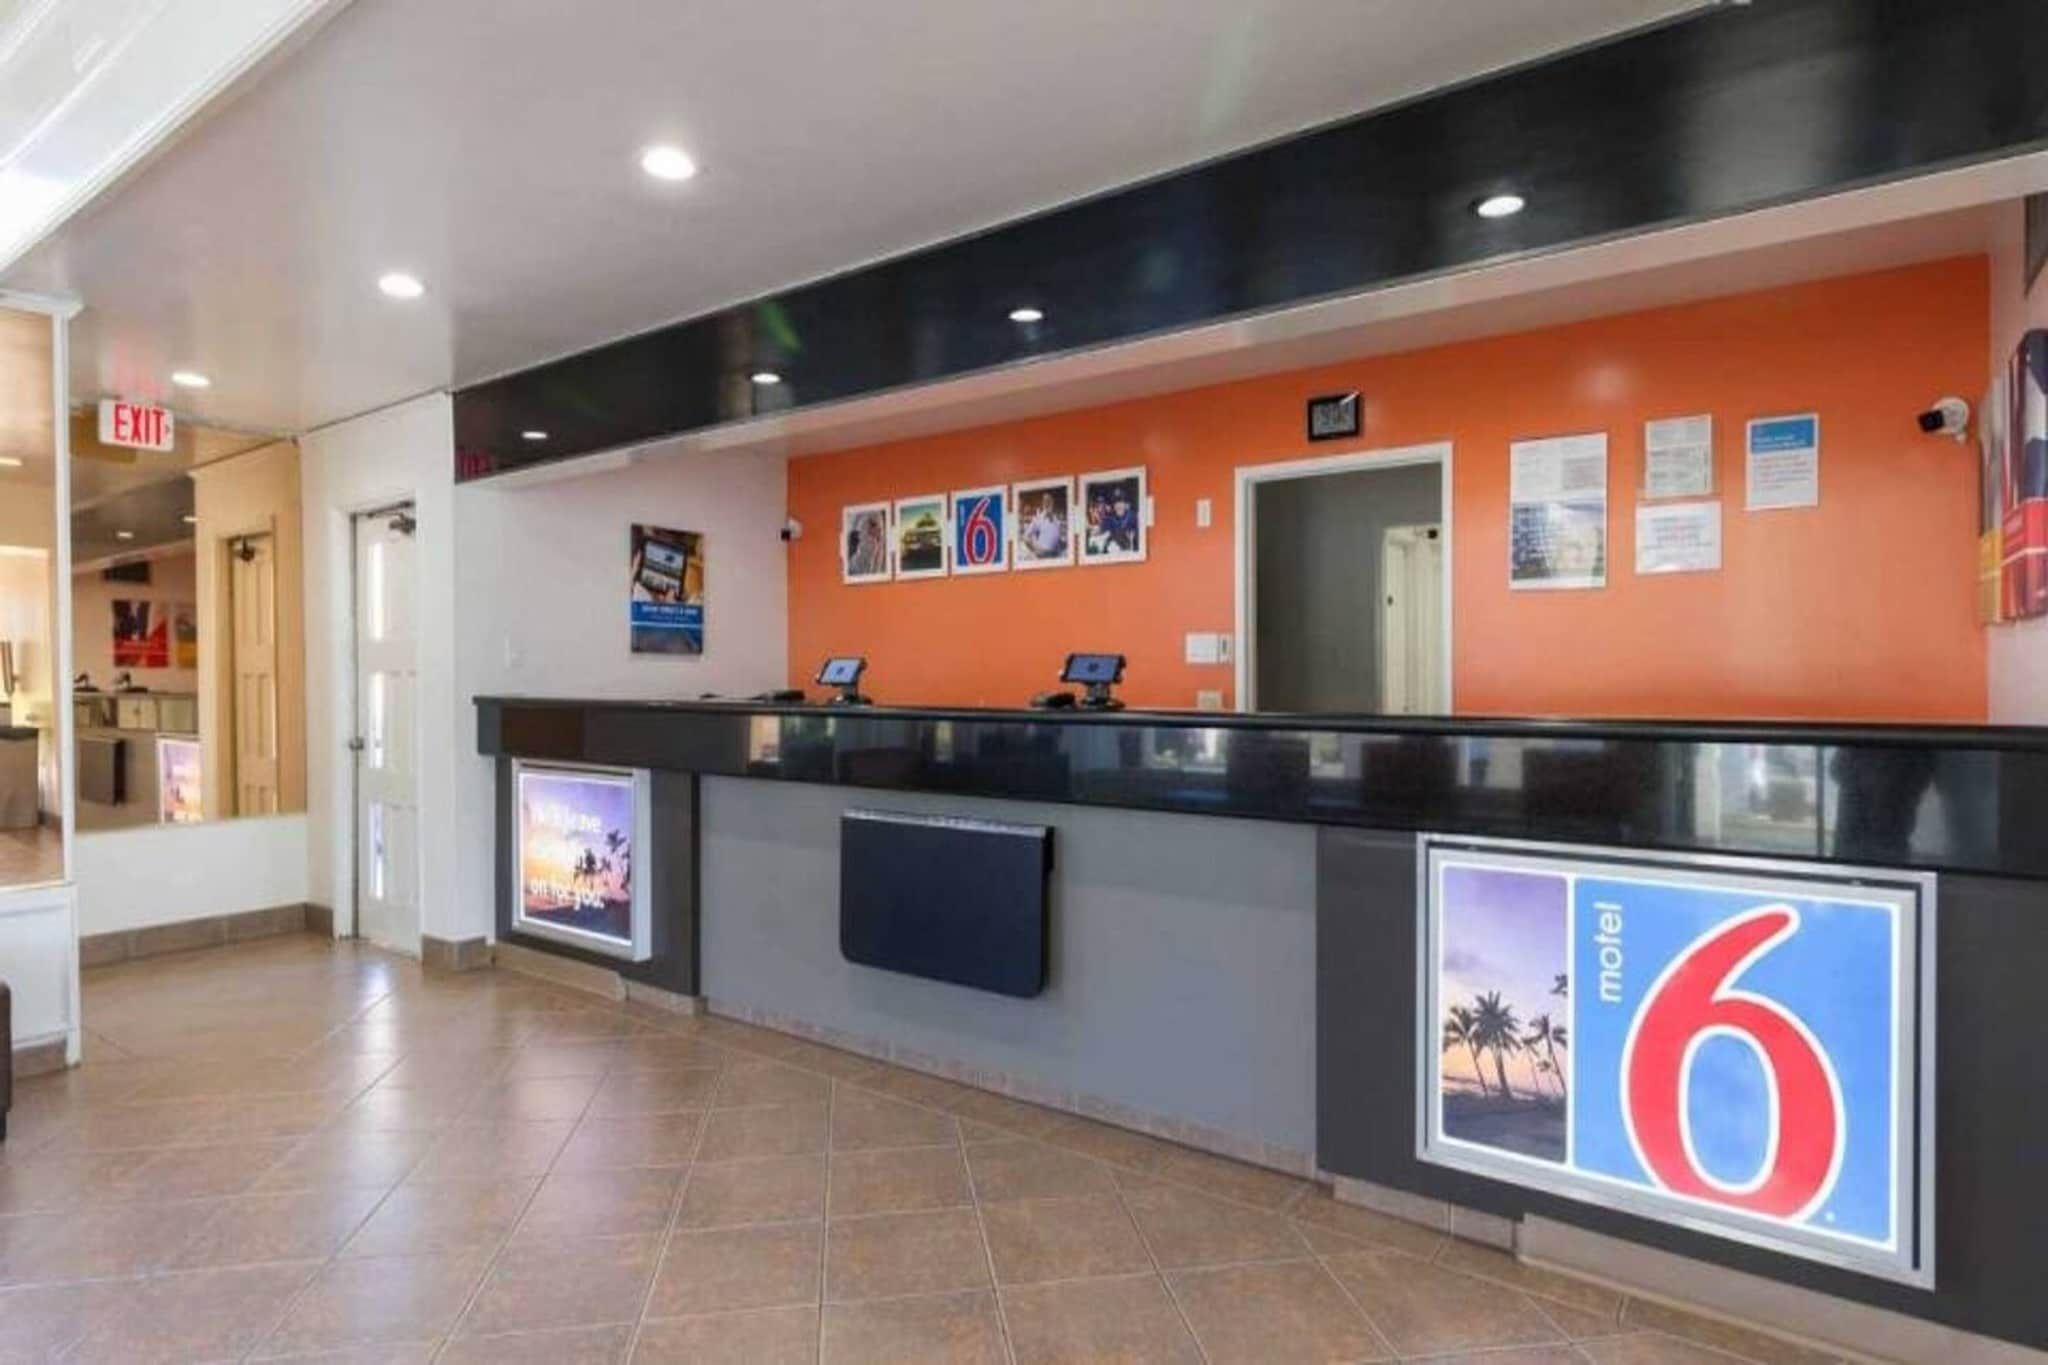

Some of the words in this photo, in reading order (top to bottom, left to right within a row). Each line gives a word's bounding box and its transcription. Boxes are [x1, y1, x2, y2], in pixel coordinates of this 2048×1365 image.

[114, 403, 164, 446] EXIT
[963, 496, 998, 567] 6
[1593, 901, 1623, 1003] motel
[1620, 903, 1846, 1224] 6
